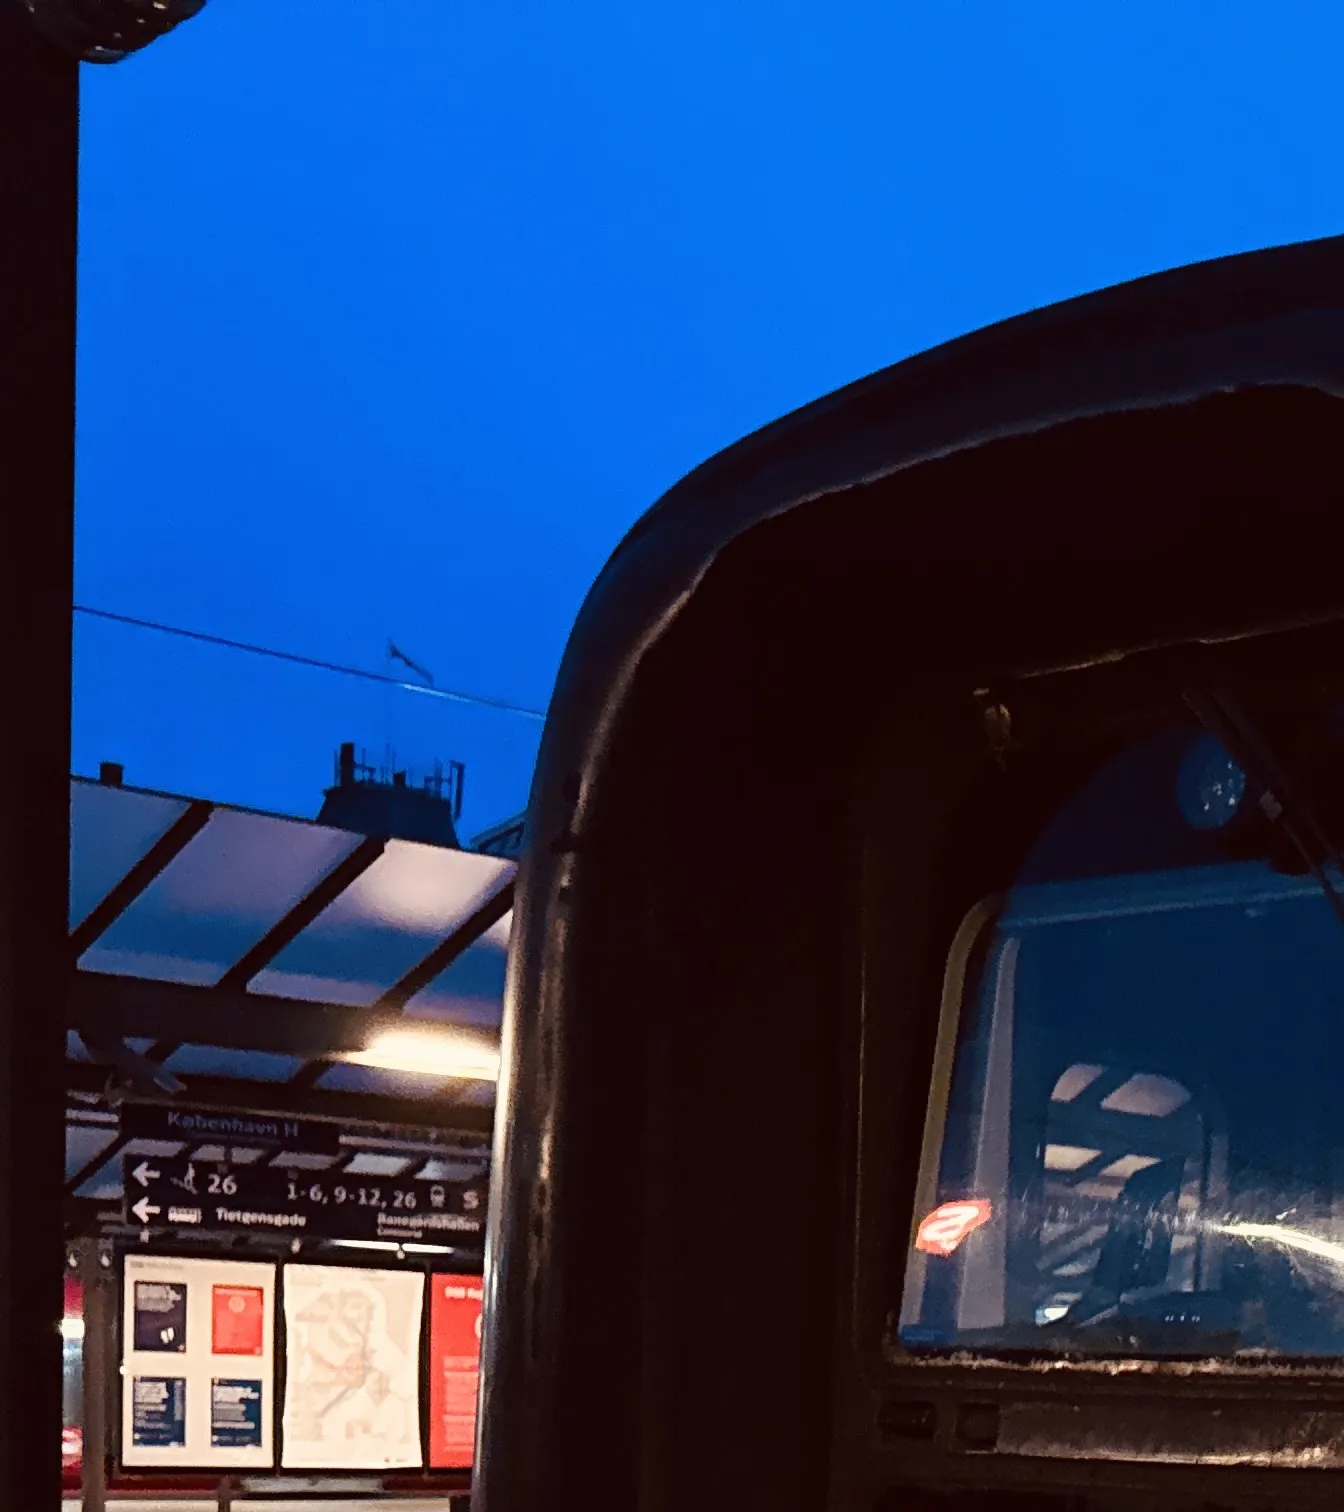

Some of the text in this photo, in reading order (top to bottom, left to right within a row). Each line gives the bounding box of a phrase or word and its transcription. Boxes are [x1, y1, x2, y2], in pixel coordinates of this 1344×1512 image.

[168, 1111, 299, 1137] København H
[207, 1173, 238, 1195] 26
[393, 1190, 417, 1209] 26
[216, 1206, 306, 1227] Tietgensgade
